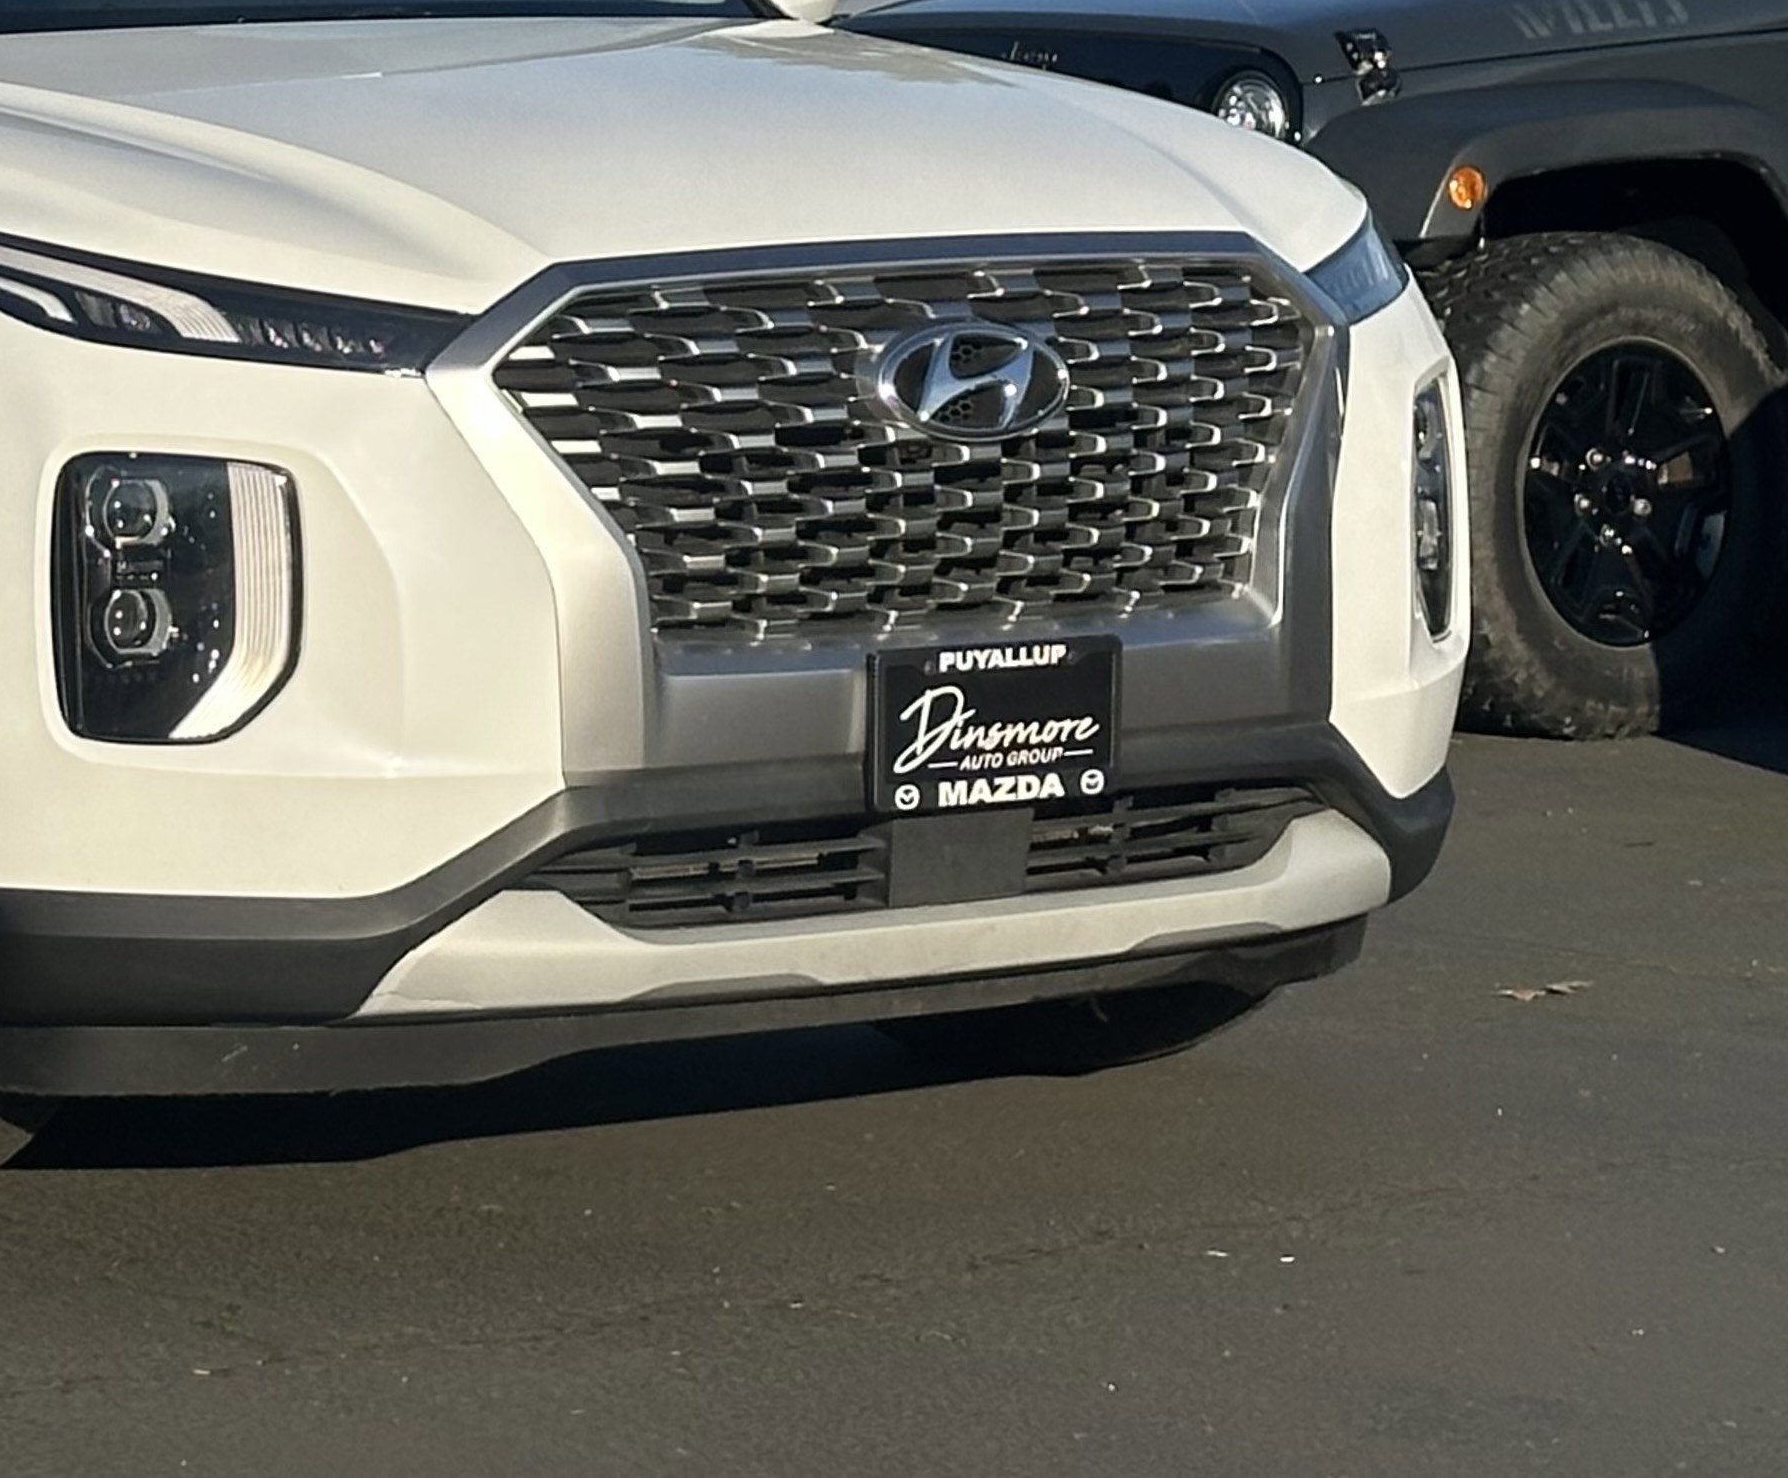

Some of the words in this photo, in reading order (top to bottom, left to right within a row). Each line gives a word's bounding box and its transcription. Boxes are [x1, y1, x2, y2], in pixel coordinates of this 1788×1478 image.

[939, 643, 1067, 673] PUYALLUP
[893, 685, 1100, 774] Dinsmore
[959, 752, 1003, 771] AUTO
[1006, 746, 1063, 767] GROUP
[938, 772, 1065, 807] MAZDA
